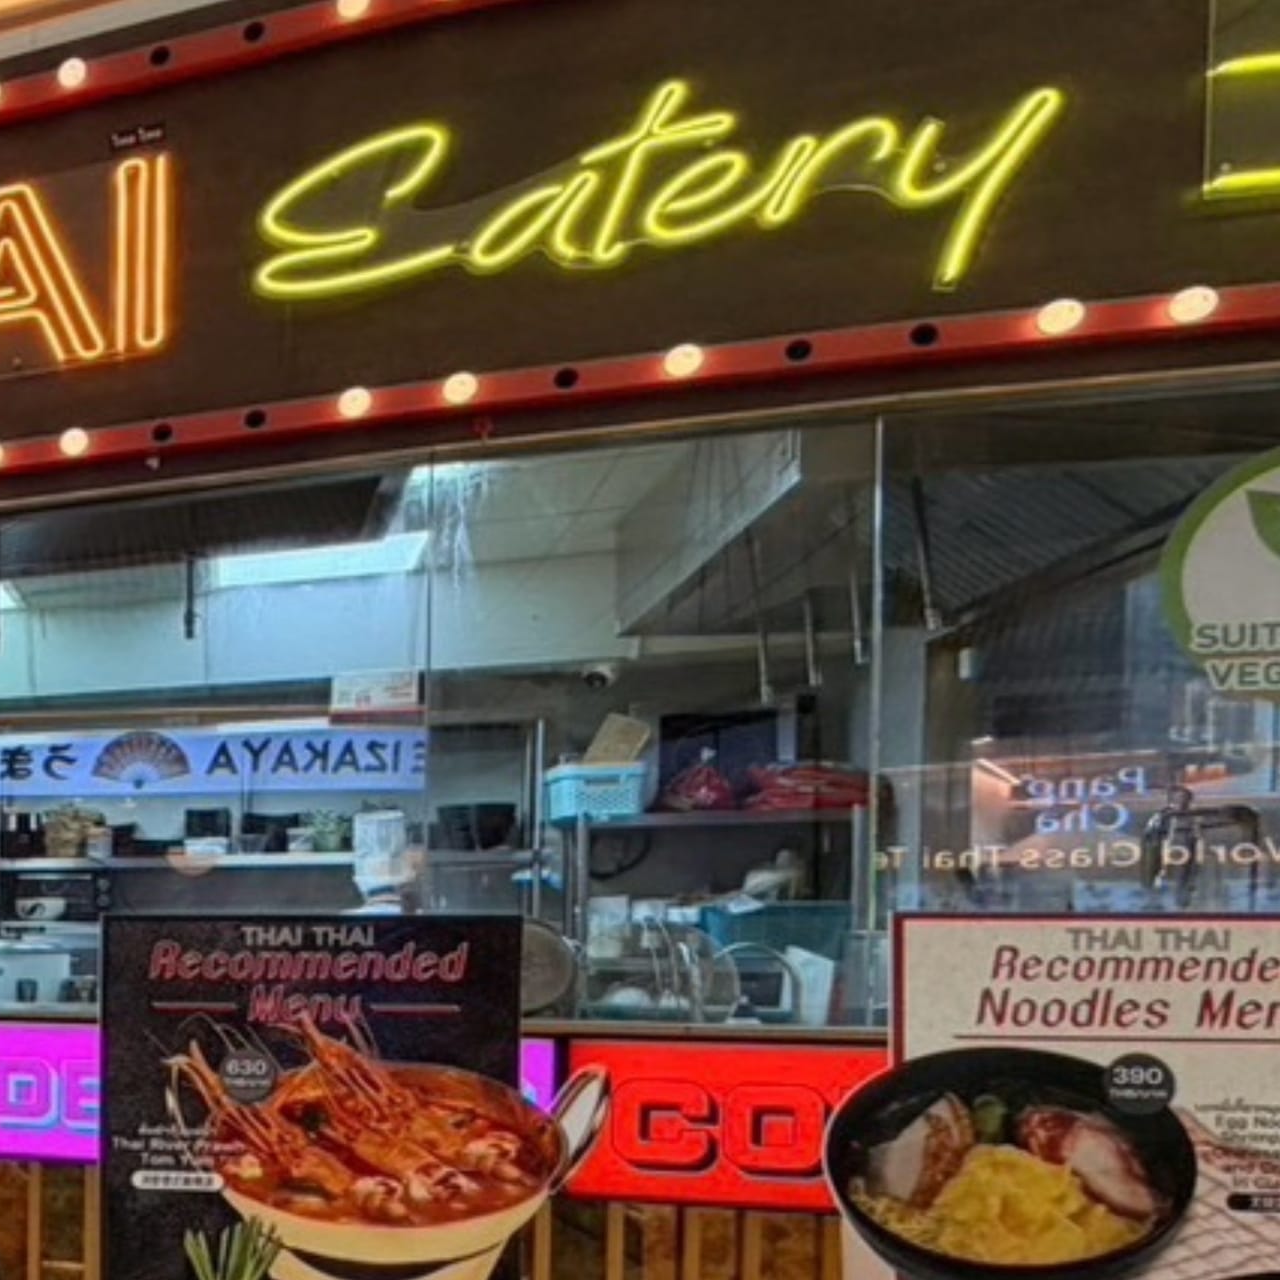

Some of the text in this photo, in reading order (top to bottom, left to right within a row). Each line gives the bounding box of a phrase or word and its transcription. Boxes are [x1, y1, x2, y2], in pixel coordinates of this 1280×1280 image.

[255, 80, 1062, 290] Eatery
[240, 926, 375, 946] THAI THAI
[1066, 927, 1231, 950] THAI THAI
[148, 940, 470, 982] Recommended
[248, 986, 364, 1023] Menu
[974, 988, 1170, 1030] Noodles
[226, 1059, 266, 1077] 630
[1111, 1065, 1162, 1086] 390
